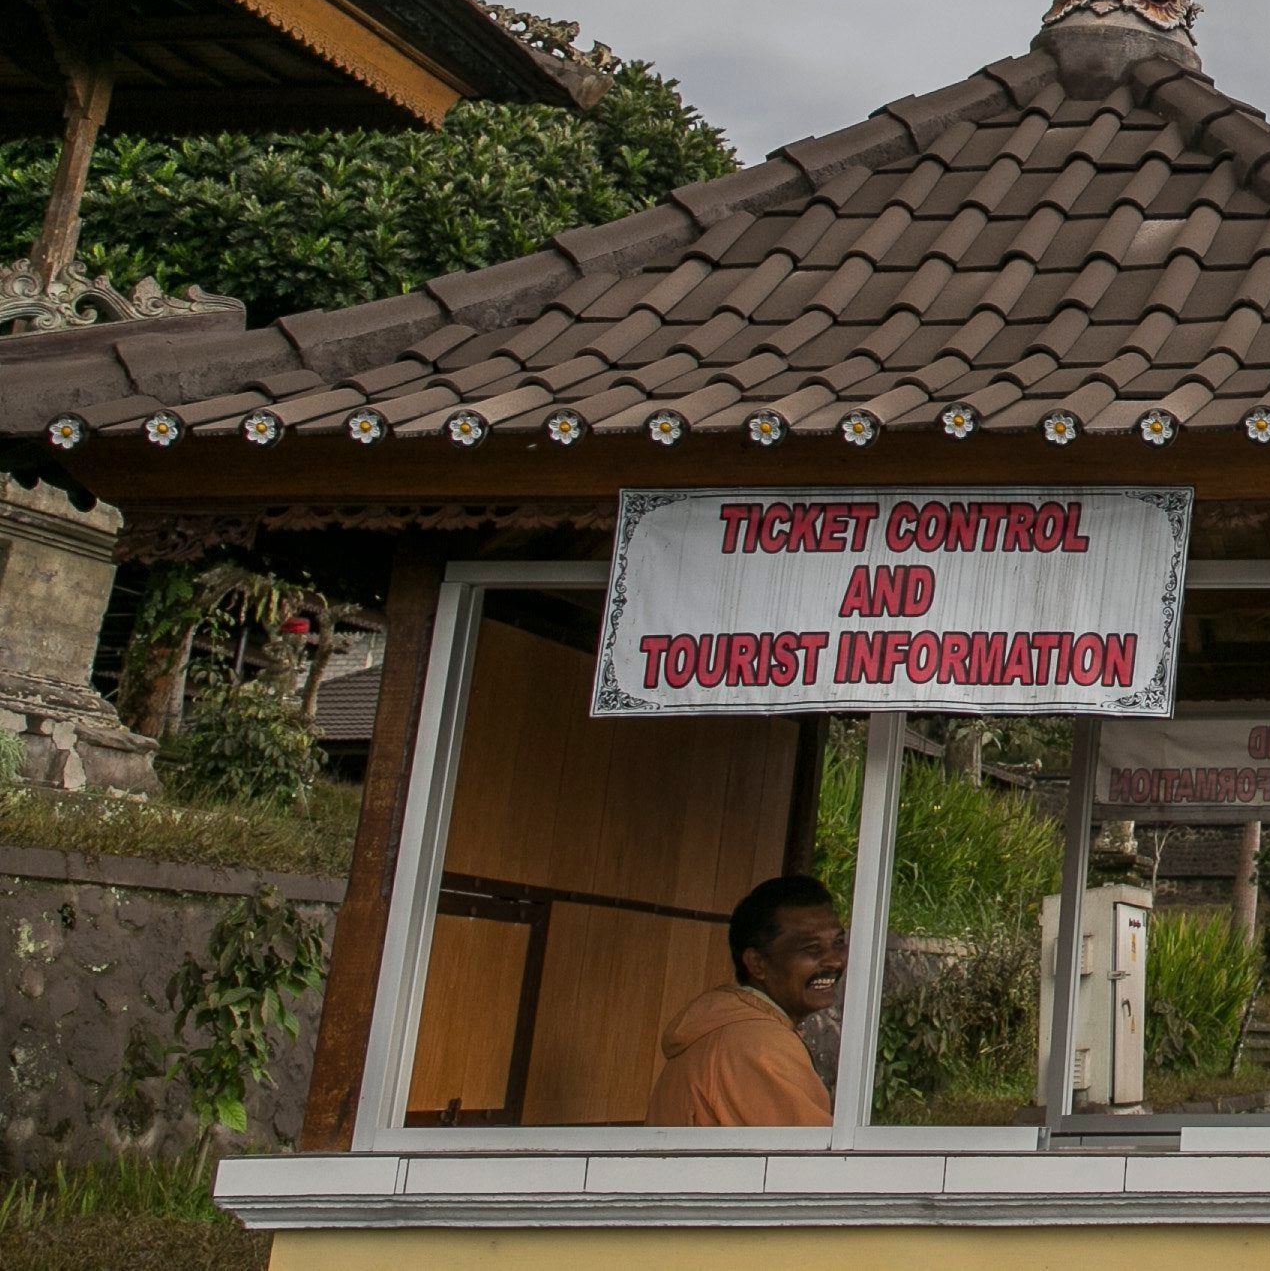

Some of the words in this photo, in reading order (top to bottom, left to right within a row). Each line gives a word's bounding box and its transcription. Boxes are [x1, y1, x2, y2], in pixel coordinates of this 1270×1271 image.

[720, 502, 877, 553] TICKET
[886, 502, 1090, 553] CONTROL
[839, 564, 936, 618] AND
[641, 631, 828, 688] TOURIST
[834, 630, 1140, 687] INFORMATION
